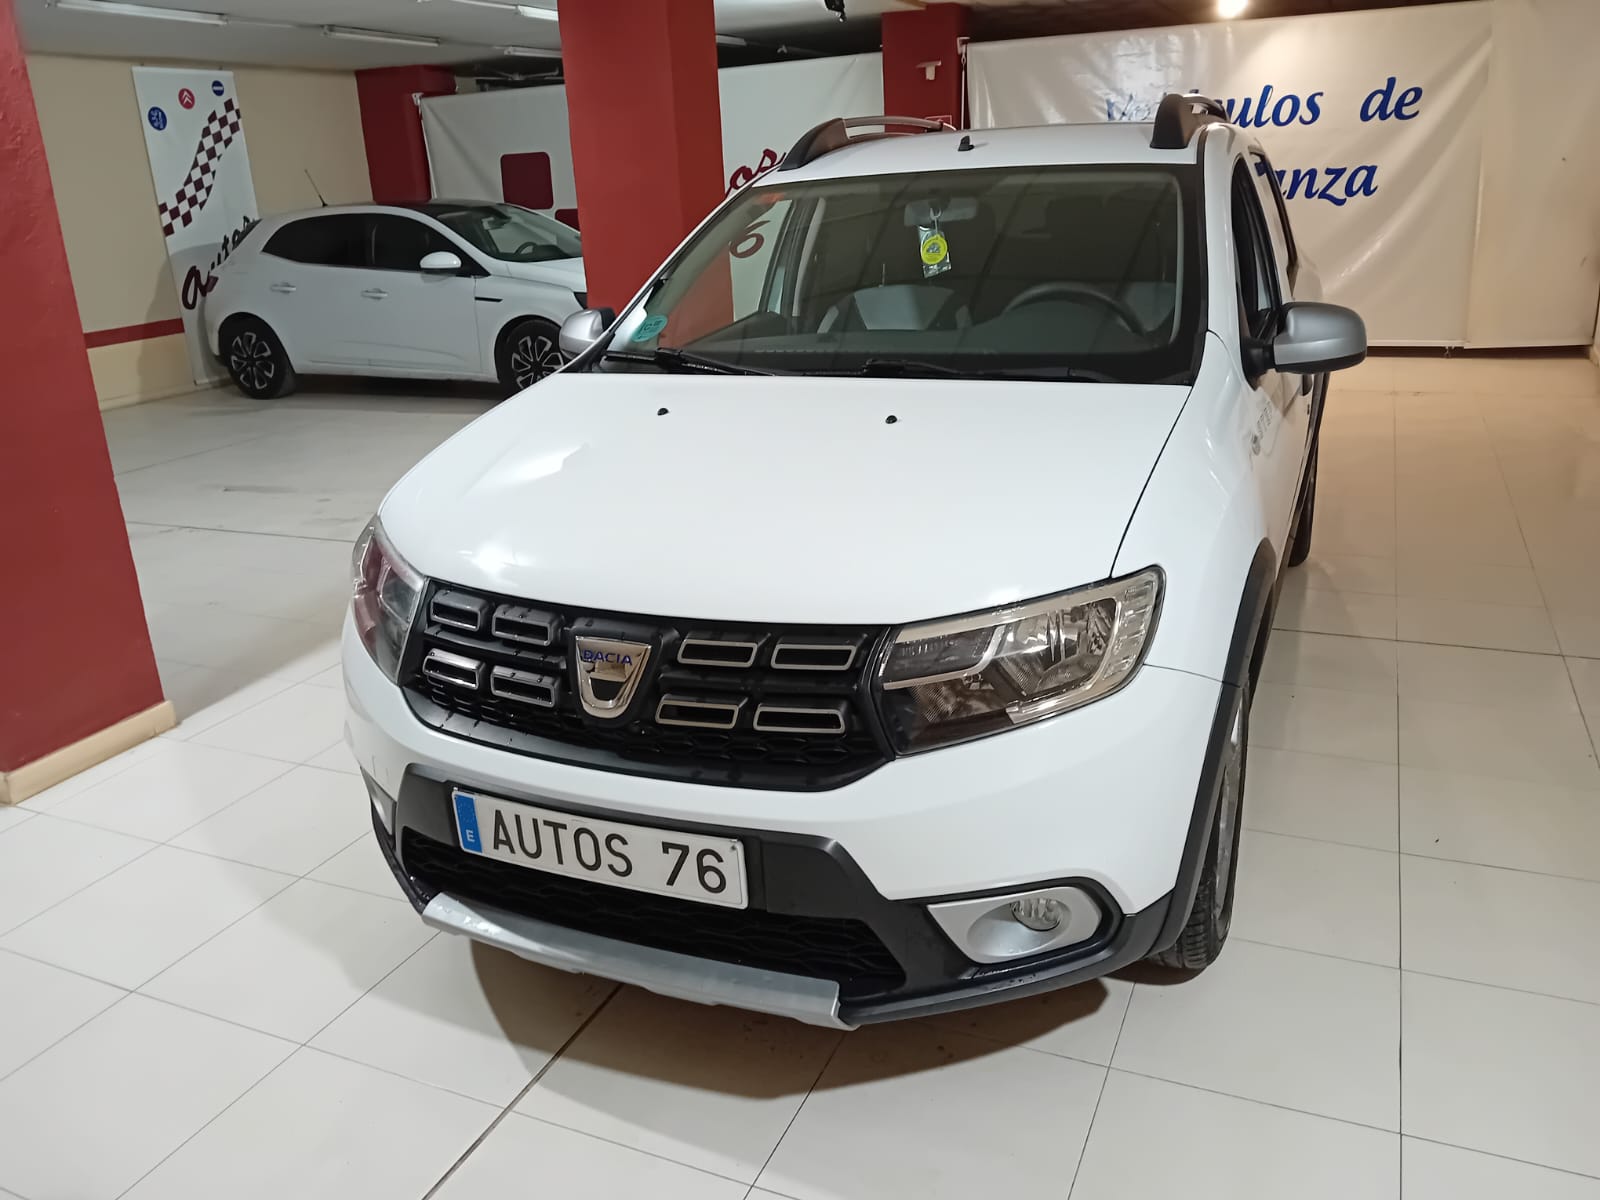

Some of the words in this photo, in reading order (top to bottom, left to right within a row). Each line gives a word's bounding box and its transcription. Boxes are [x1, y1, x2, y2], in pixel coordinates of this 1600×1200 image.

[1359, 76, 1424, 122] de
[582, 648, 633, 666] DACIA
[465, 828, 476, 843] E
[492, 809, 633, 878] AUTOS
[661, 840, 727, 894] 76
